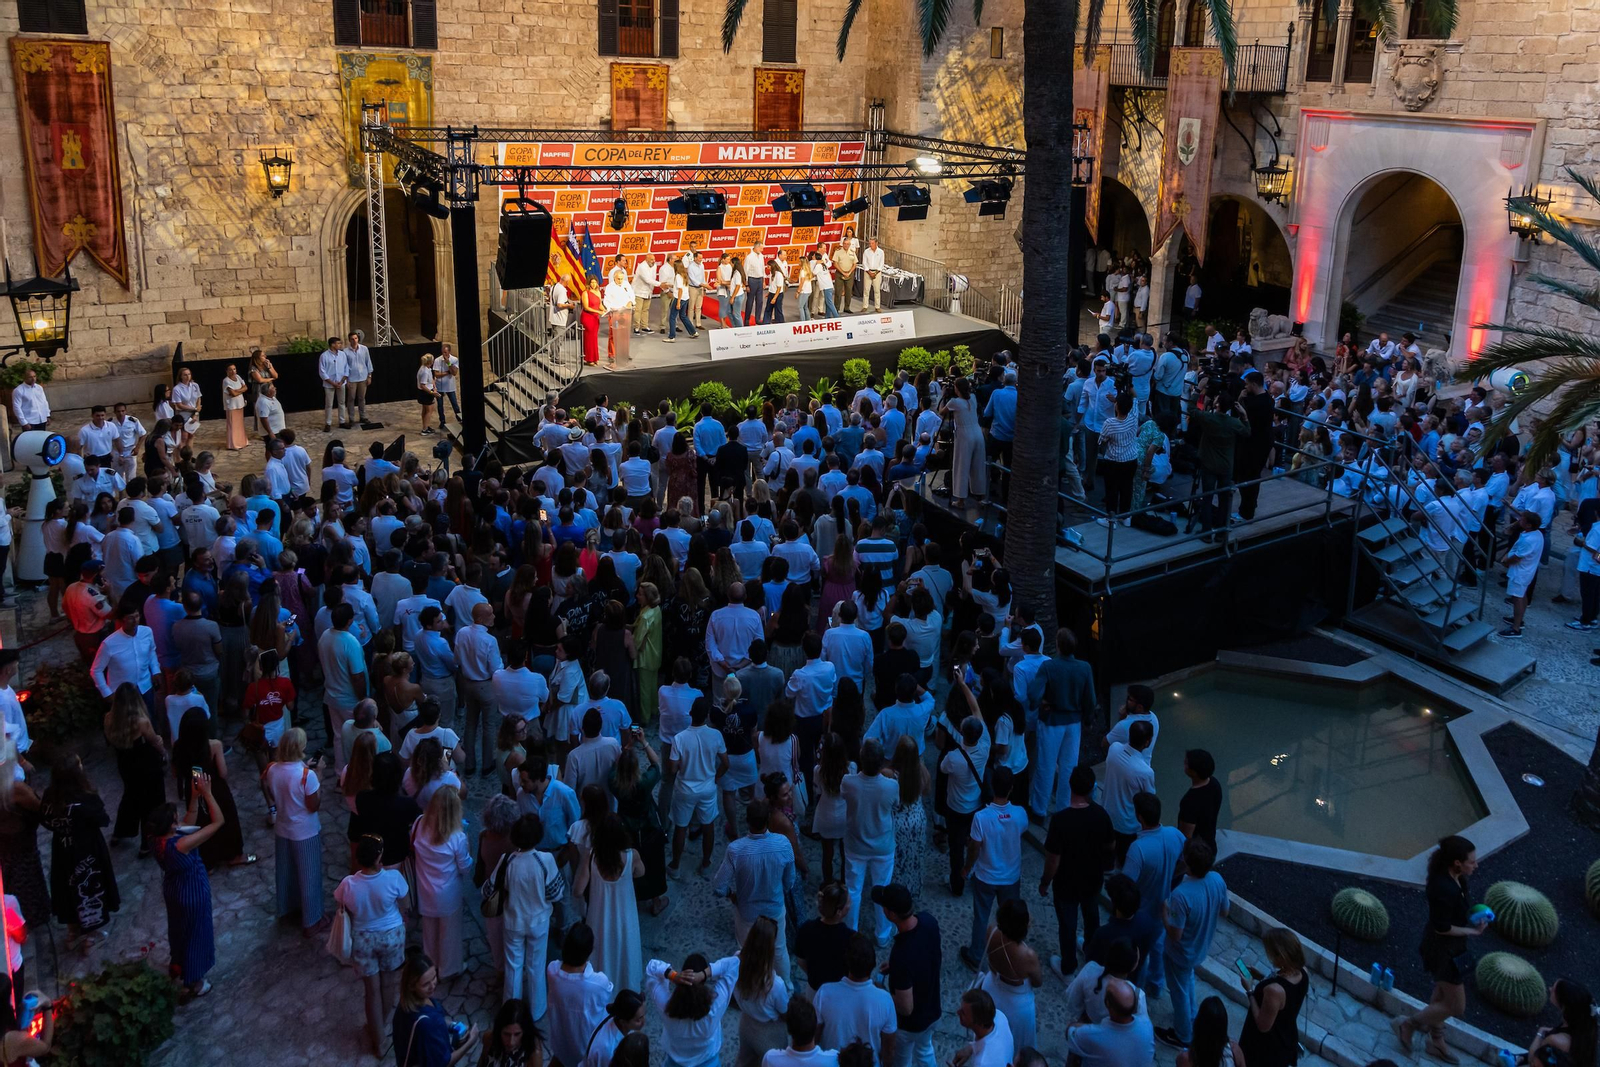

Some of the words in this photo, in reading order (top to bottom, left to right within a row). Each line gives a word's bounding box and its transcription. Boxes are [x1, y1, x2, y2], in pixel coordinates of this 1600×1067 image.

[584, 148, 627, 161] COPA
[628, 150, 642, 158] DEL
[643, 148, 671, 161] REY
[718, 146, 796, 160] MAPFRE
[751, 195, 762, 203] REY
[566, 201, 582, 209] REY
[736, 216, 748, 224] REY
[631, 243, 645, 251] REY
[793, 321, 842, 335] MAPFRE
